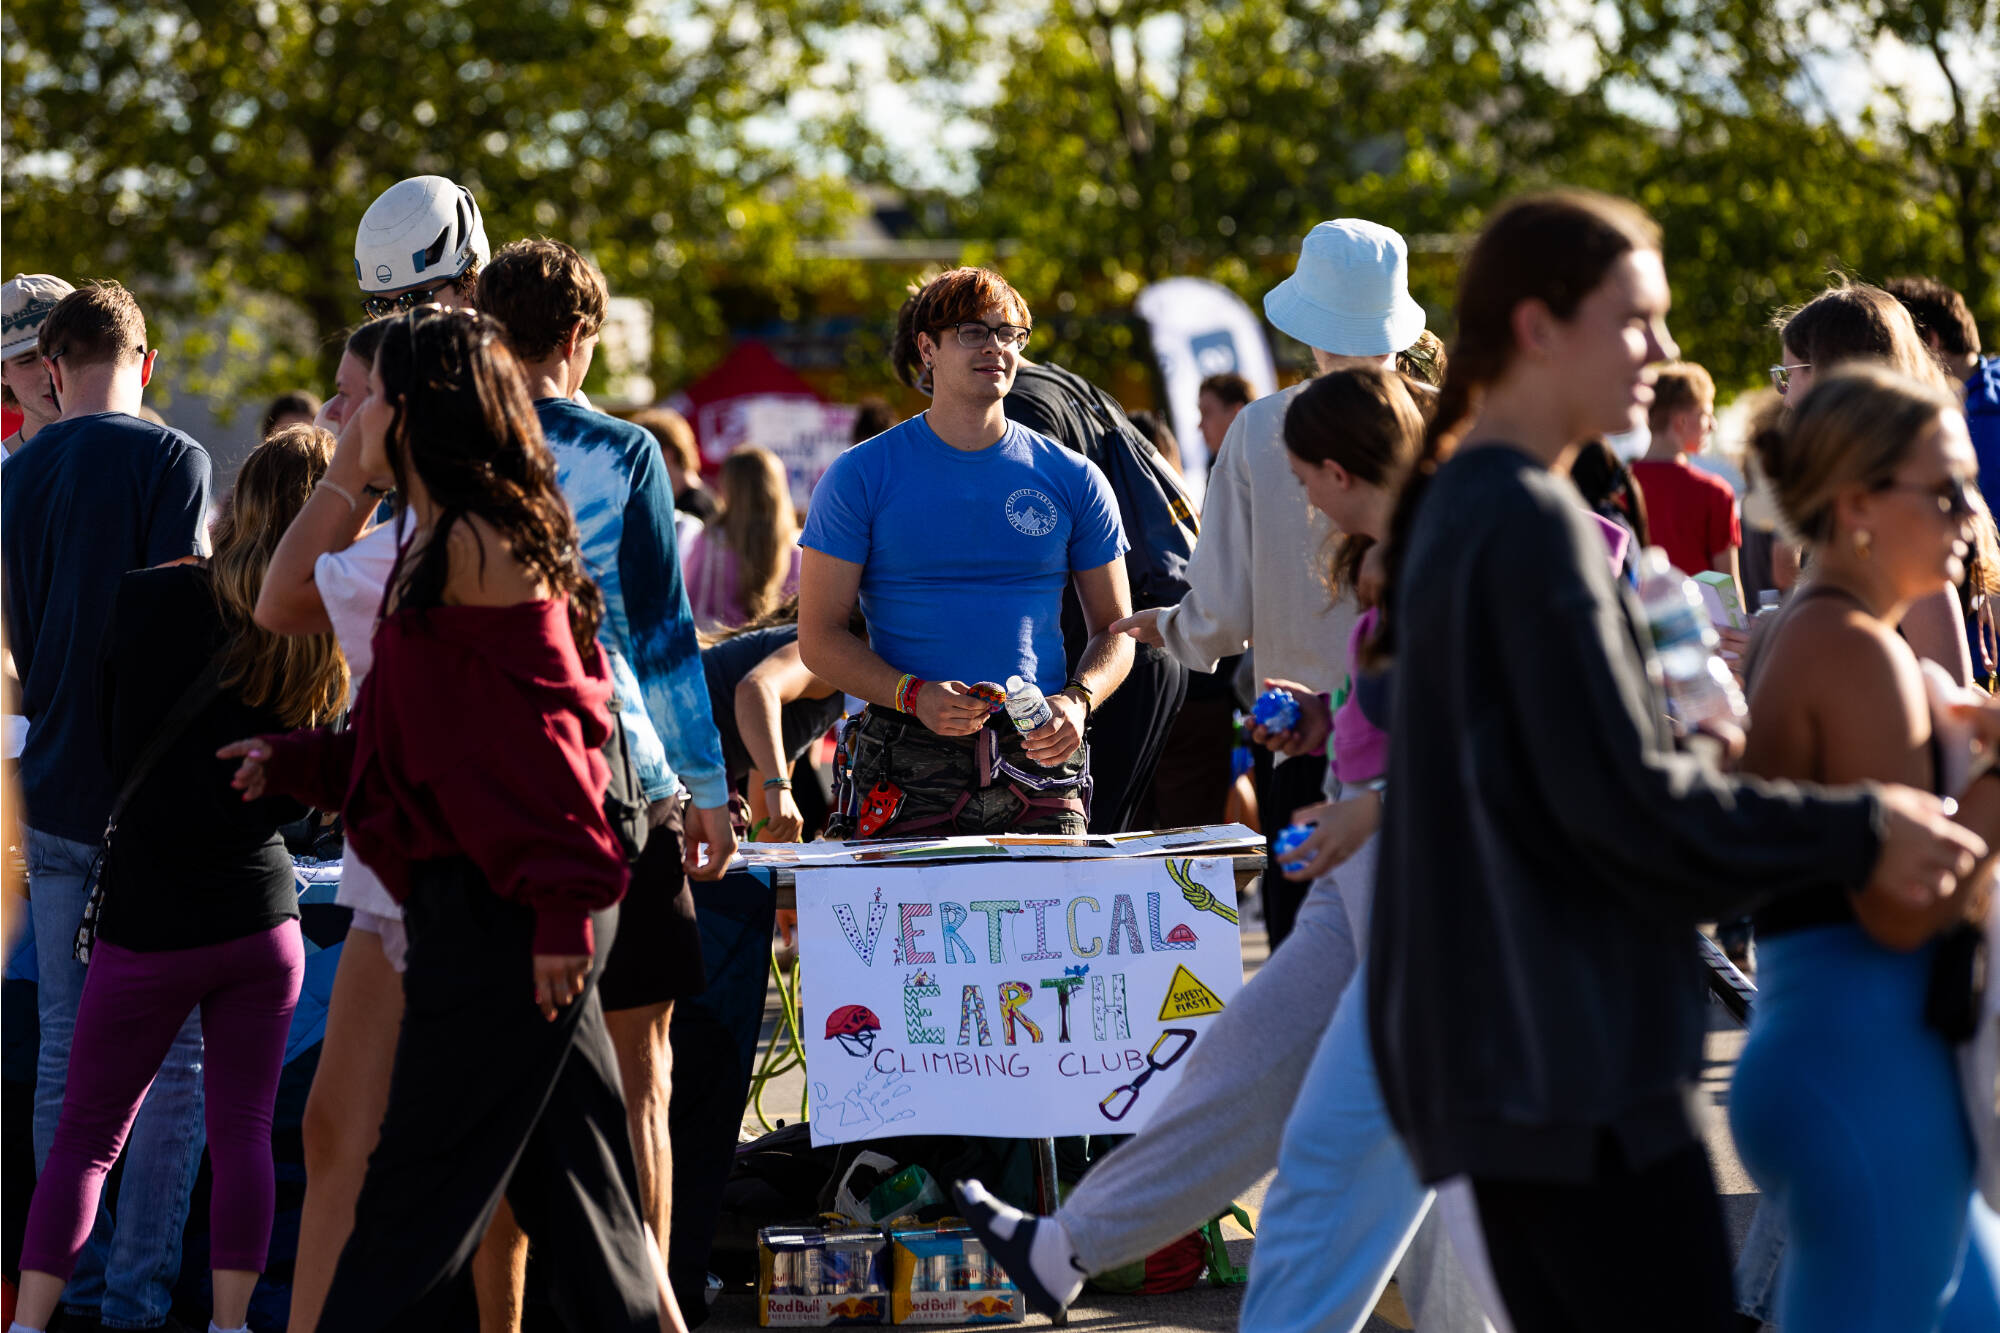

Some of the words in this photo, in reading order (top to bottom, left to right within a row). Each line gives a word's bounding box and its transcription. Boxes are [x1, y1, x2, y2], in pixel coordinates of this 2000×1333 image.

[832, 892, 1197, 967] VERTICAL
[1174, 988, 1206, 1003] SAFETY
[904, 972, 1131, 1046] EARTH
[874, 1048, 1030, 1077] CLIMBING
[1058, 1049, 1144, 1077] CLUB
[768, 1299, 794, 1313] Red
[796, 1299, 820, 1313] Bull
[932, 1297, 957, 1312] Bull
